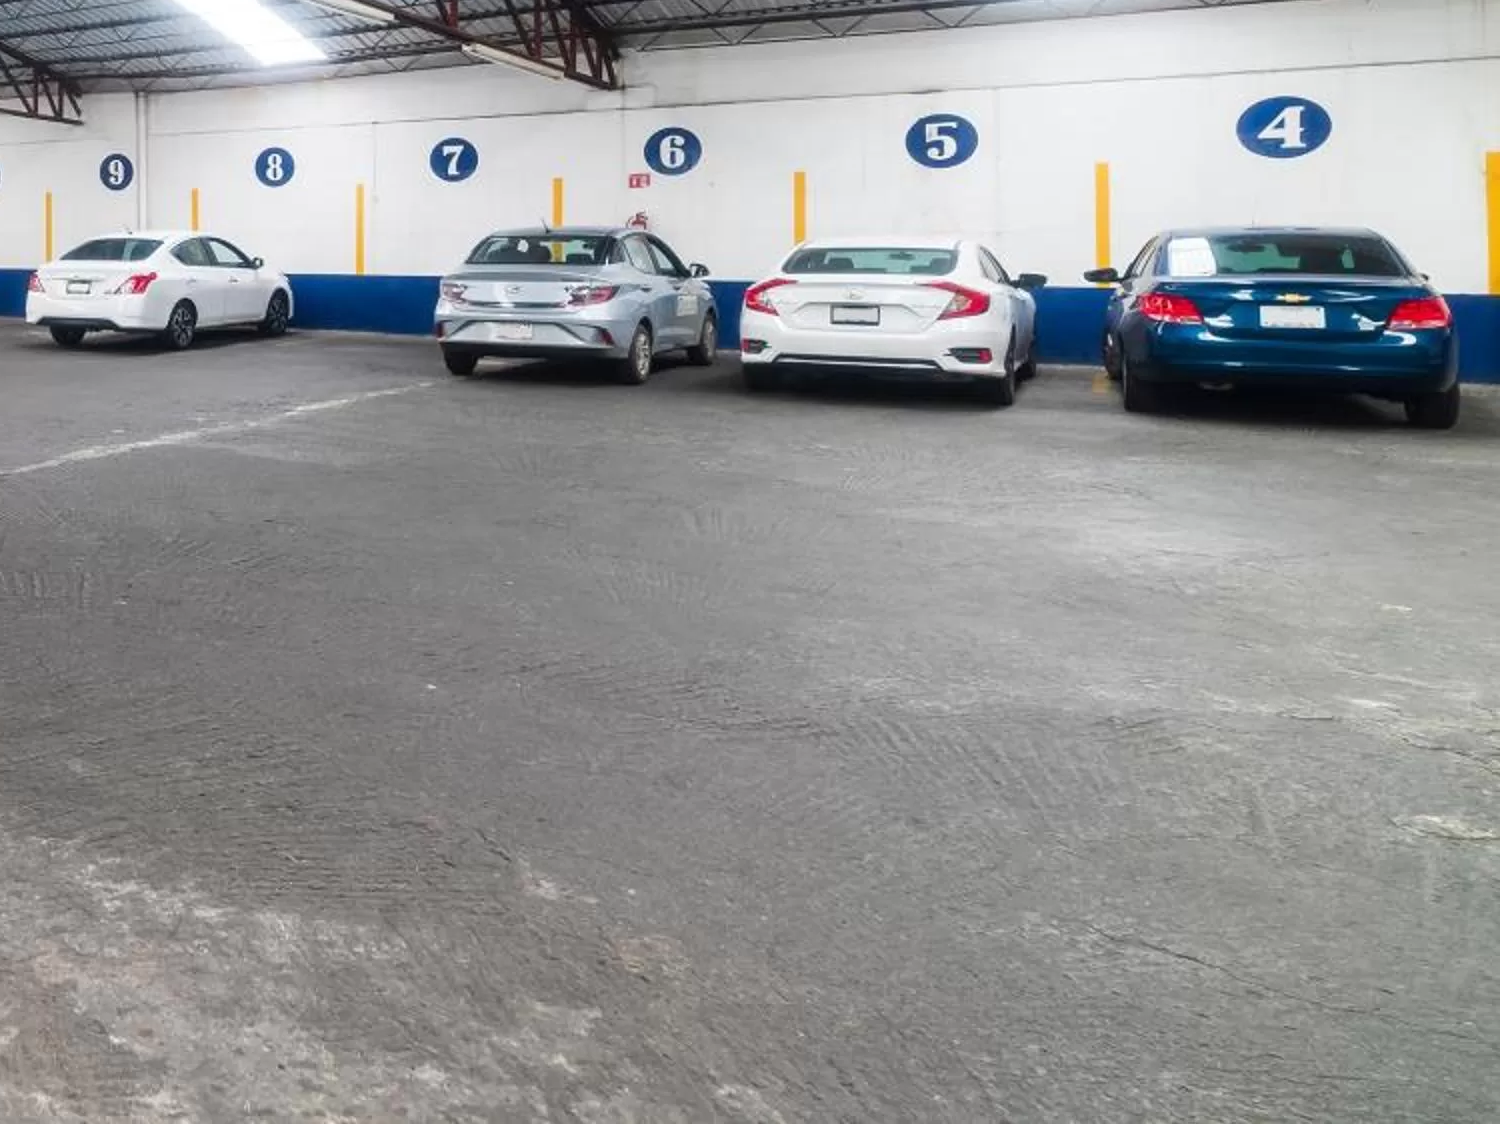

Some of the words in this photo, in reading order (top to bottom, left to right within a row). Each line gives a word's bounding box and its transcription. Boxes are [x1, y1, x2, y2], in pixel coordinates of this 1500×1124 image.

[925, 122, 957, 160] 5
[1258, 105, 1306, 148] 4
[266, 153, 284, 180] 8
[443, 145, 464, 175] 7
[659, 135, 685, 168] 6
[109, 159, 125, 185] 9
